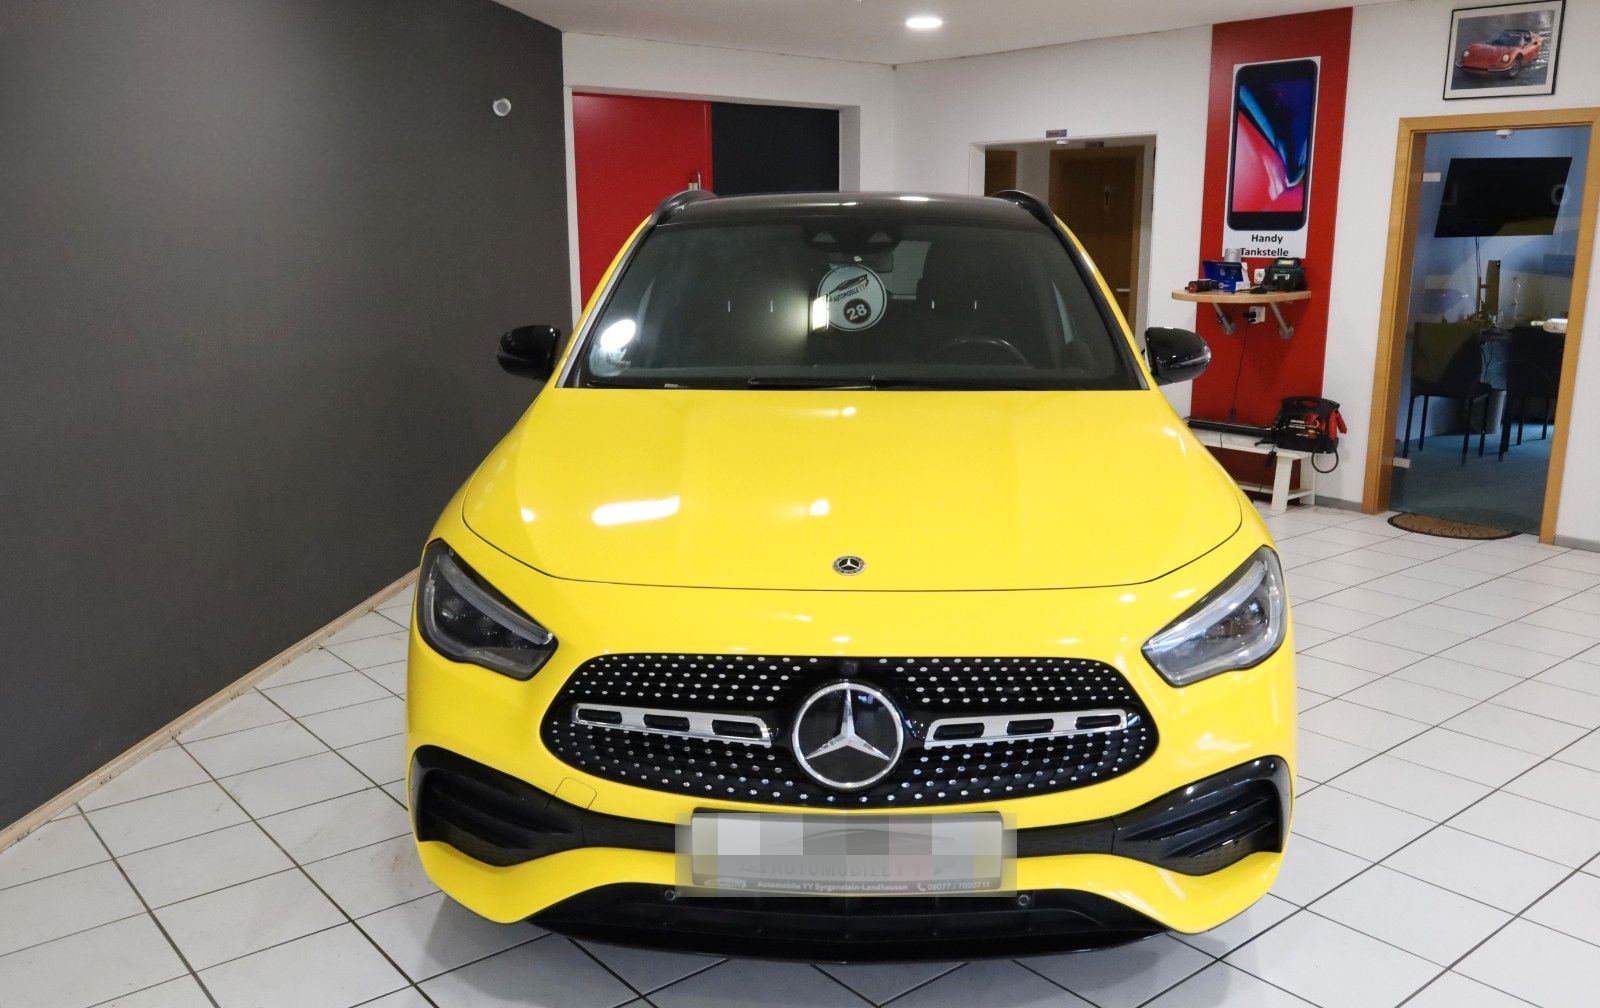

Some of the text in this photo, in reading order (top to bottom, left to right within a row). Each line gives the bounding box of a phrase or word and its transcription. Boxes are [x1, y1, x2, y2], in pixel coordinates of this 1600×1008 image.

[1251, 234, 1283, 244] Handy
[1240, 247, 1289, 256] Tankstelle
[846, 304, 868, 321] 28
[771, 858, 890, 877] AUTOMOBILE
[757, 880, 801, 890] Automobile
[802, 882, 813, 890] YY
[815, 882, 908, 892] Syrgenstein-Landhausen
[927, 883, 951, 891] 09077
[958, 880, 990, 890] 7000711
